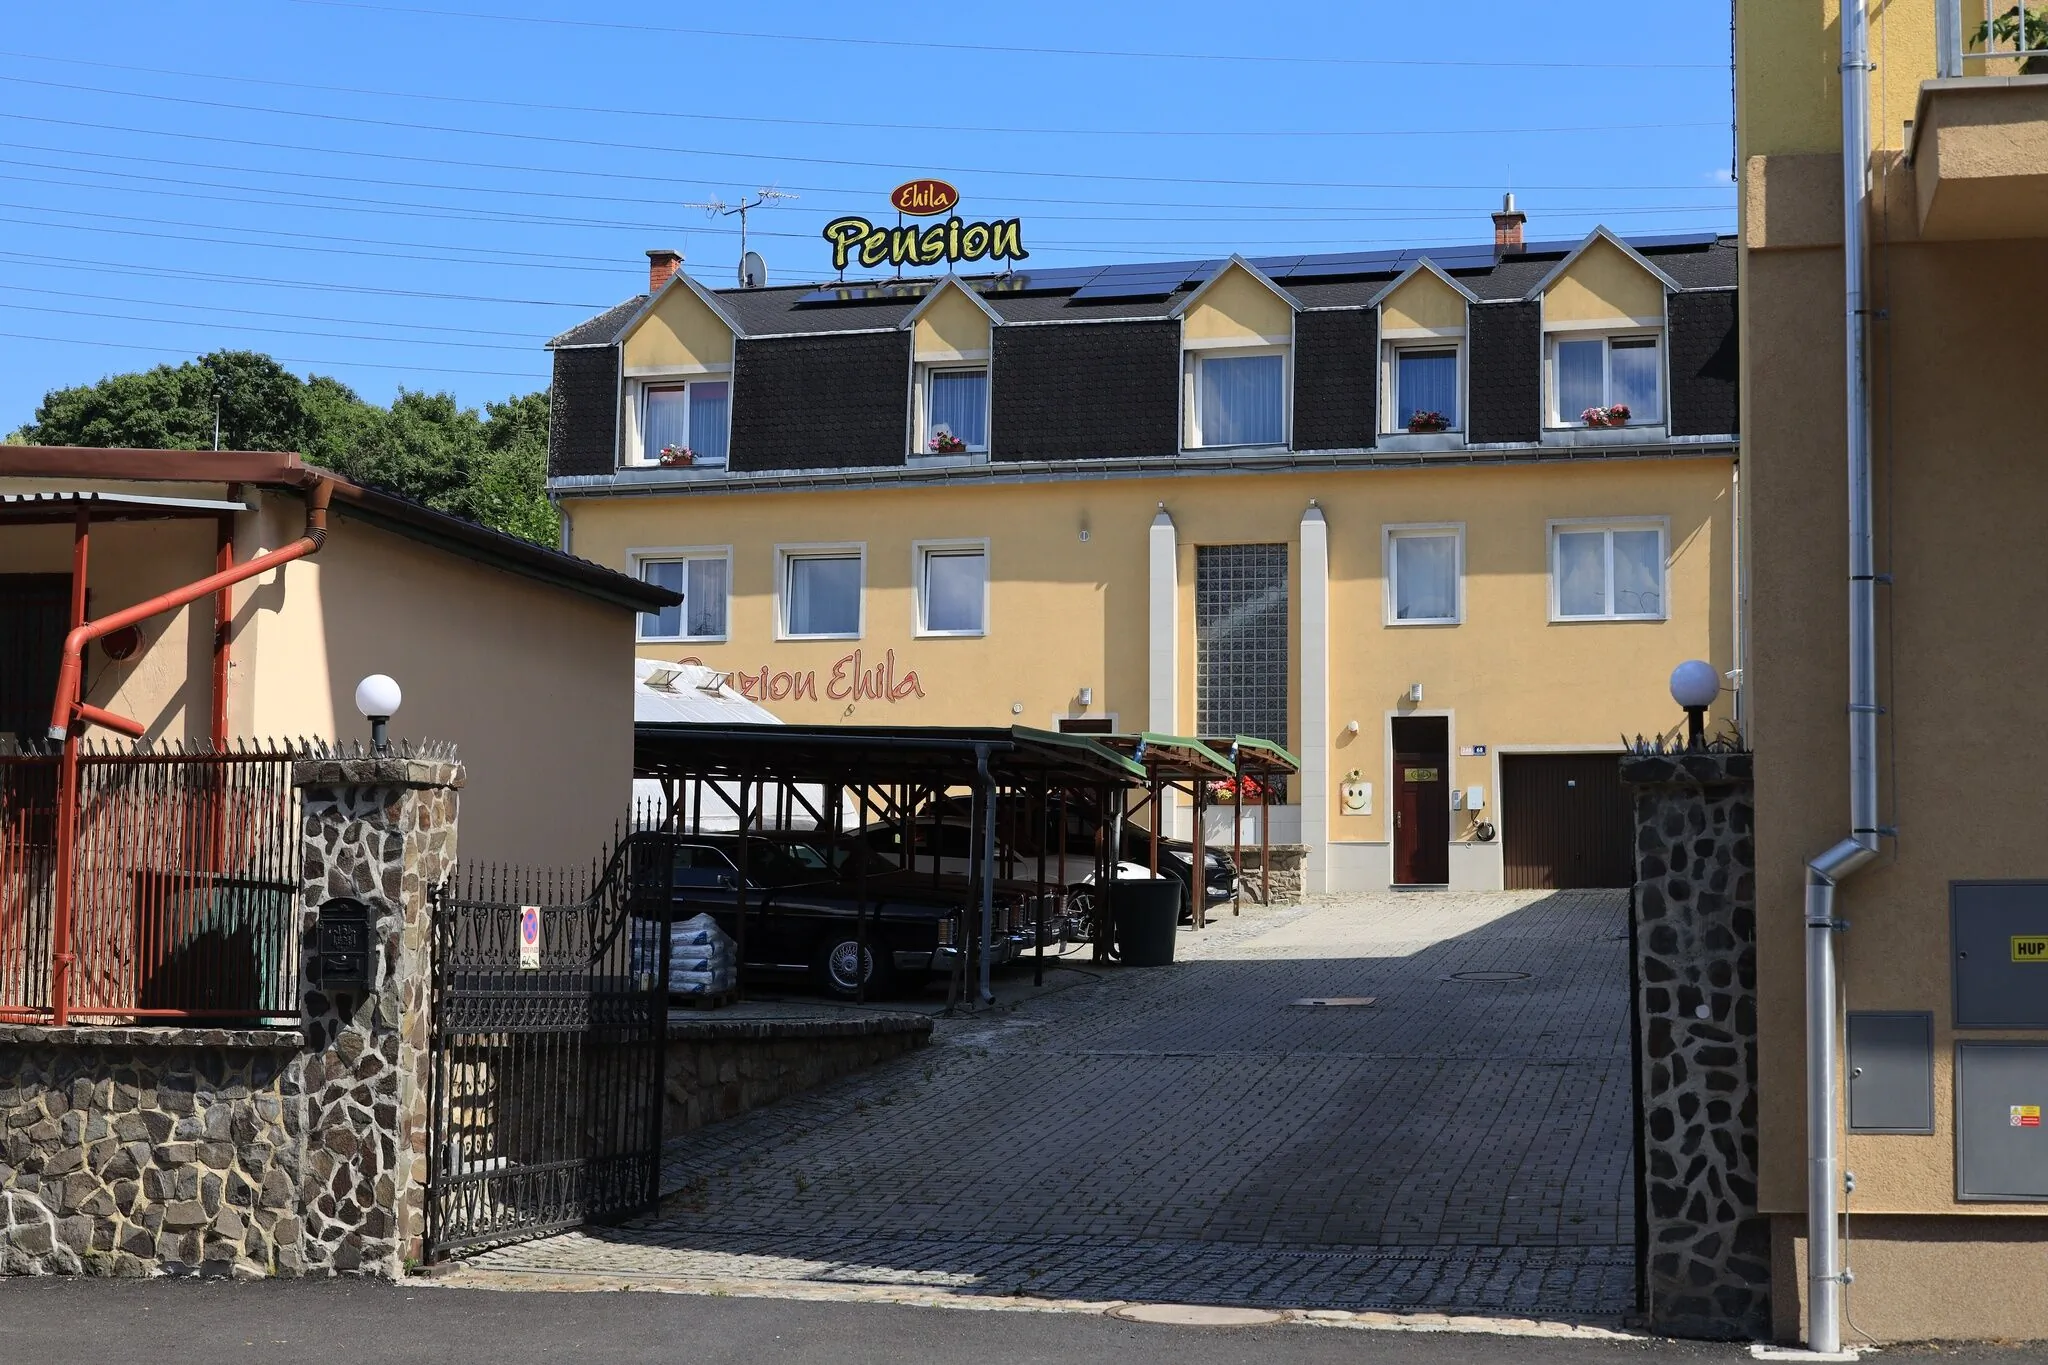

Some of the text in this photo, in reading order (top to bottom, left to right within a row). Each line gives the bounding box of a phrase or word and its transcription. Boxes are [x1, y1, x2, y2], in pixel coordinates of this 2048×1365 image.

[900, 184, 949, 207] Ehila
[825, 218, 1025, 268] Pension
[826, 649, 925, 703] Ehila
[2018, 942, 2045, 955] HUP
